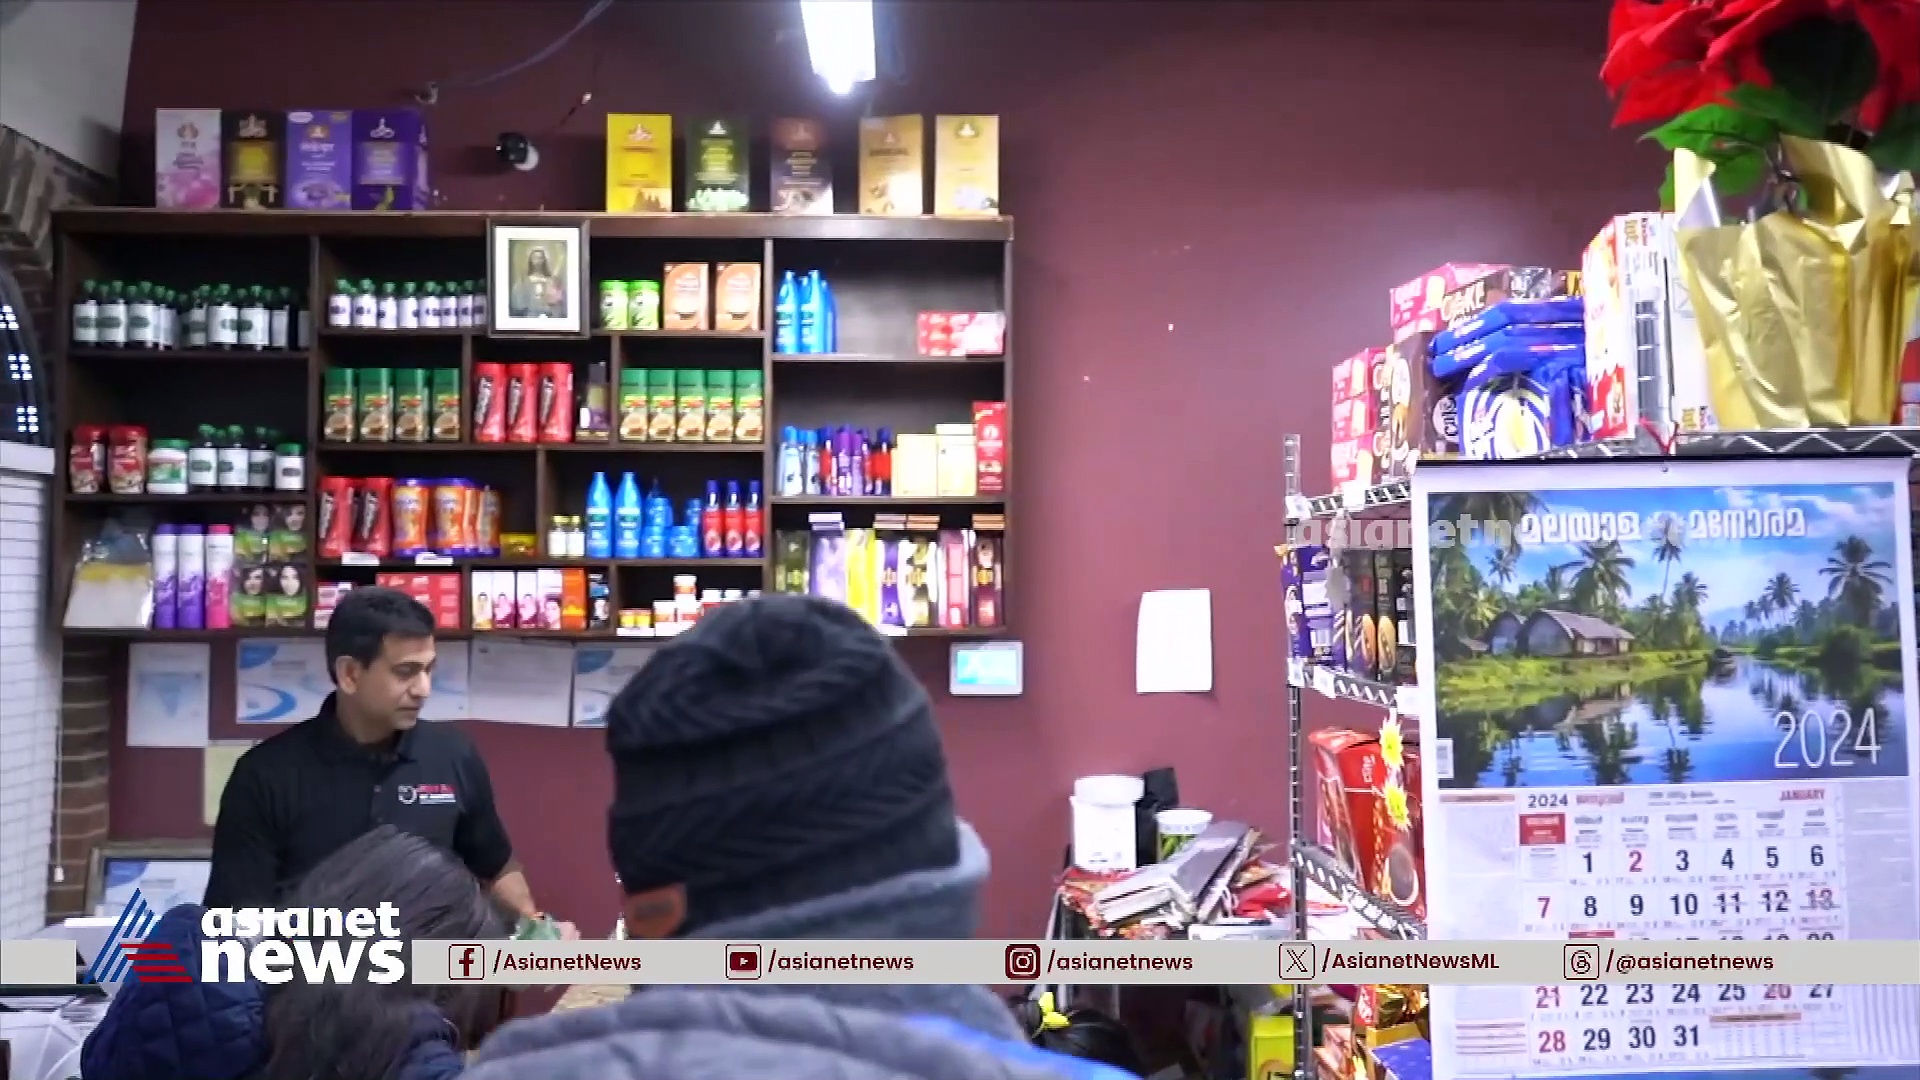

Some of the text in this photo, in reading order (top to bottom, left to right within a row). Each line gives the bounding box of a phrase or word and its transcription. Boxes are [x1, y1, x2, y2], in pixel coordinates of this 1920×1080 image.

[1775, 708, 1881, 768] 2024
[1527, 793, 1570, 808] 2024
[1583, 844, 1824, 873] 1 2 3 4 5 6
[1538, 898, 1550, 918] 7
[1584, 896, 1597, 917] 8
[1630, 894, 1643, 917] 9
[1670, 894, 1698, 916] 10
[1717, 892, 1741, 914] 11
[1763, 890, 1788, 912] 12
[1536, 985, 1561, 1009] 21
[1580, 984, 1608, 1006] 22
[1626, 984, 1654, 1004] 23
[1672, 984, 1701, 1003] 24
[1718, 984, 1746, 1001] 25
[1539, 1025, 1698, 1053] 28 29 30 31
